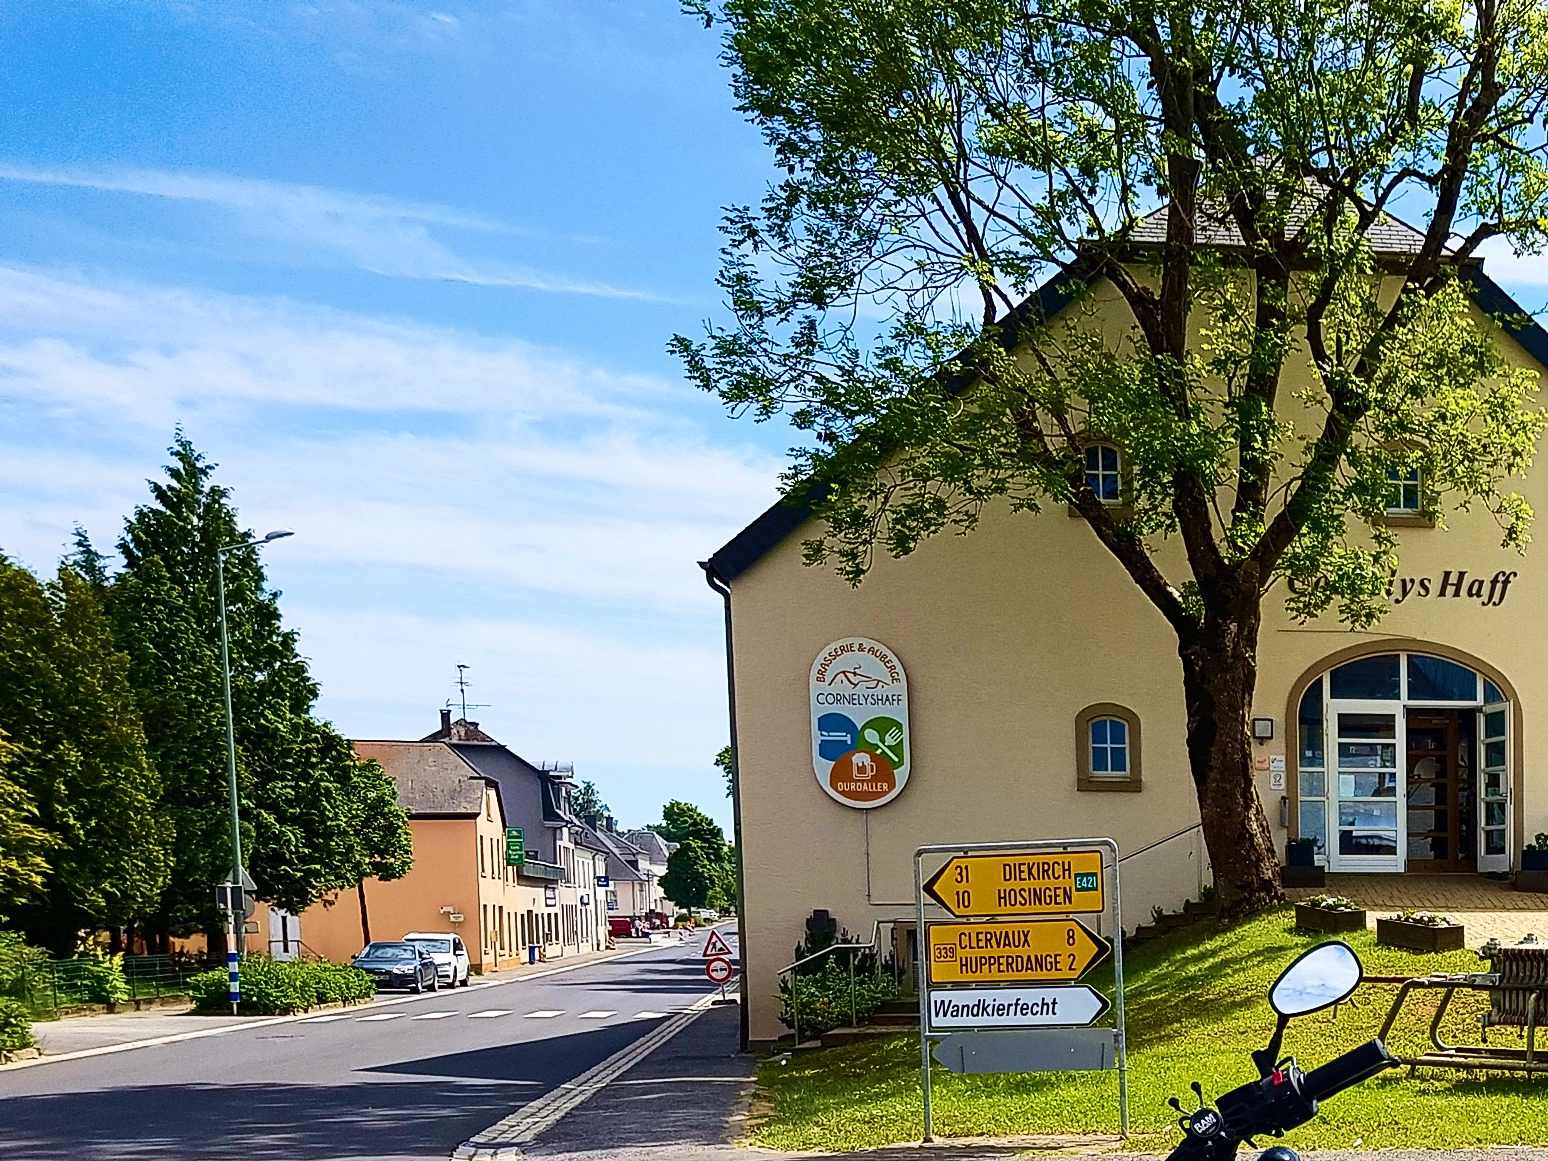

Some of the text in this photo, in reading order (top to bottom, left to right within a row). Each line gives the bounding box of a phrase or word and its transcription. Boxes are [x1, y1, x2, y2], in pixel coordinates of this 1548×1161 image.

[816, 643, 901, 684] BRASSERIE & AUBERGE
[816, 692, 903, 706] CORNELYSHAFF
[837, 781, 889, 792] OURDALLER
[954, 860, 1072, 884] 31 DIEKIRCH
[1076, 875, 1097, 889] E421
[955, 886, 1073, 909] 10 HOSINGEN
[958, 928, 1076, 950] CLERVAUX 8
[935, 946, 955, 960] 339
[959, 953, 1077, 975] HUPPERDANGE 2
[934, 997, 1058, 1018] Wandkierfecht
[1194, 1112, 1217, 1133] RAM
